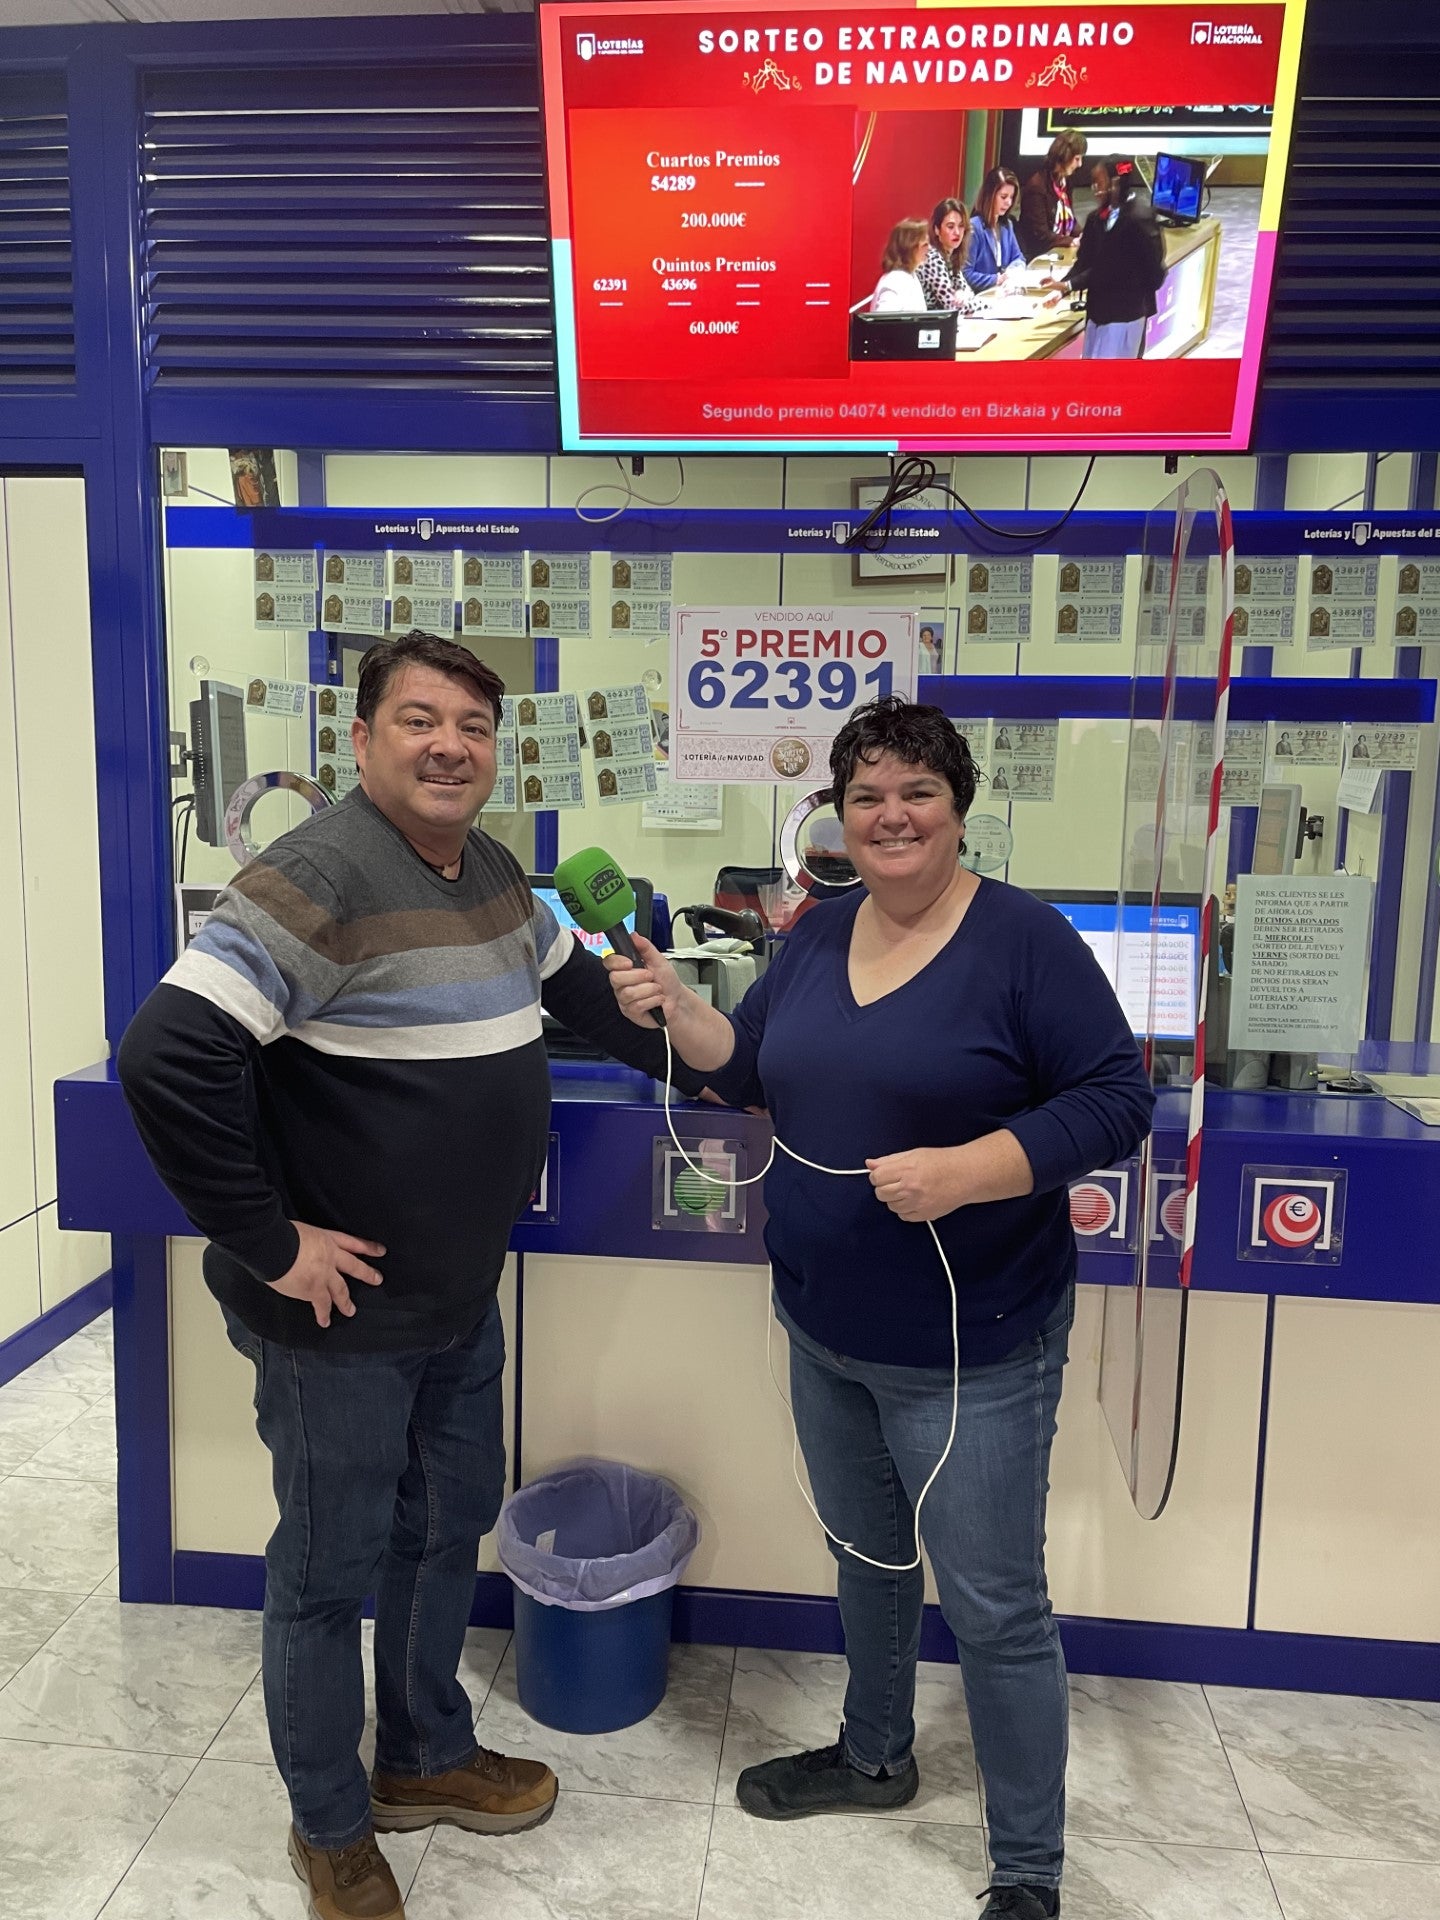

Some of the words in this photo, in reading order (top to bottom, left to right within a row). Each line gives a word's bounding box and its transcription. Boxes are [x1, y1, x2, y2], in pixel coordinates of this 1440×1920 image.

[1213, 24, 1255, 35] LOTERÍA
[597, 38, 644, 49] LOTERÍAS
[698, 29, 823, 54] SORTEO
[838, 22, 1134, 50] EXTRAORDINARIO
[1213, 34, 1263, 45] NACIONAL
[815, 62, 851, 86] DE
[866, 59, 1013, 84] NAVIDAD
[646, 151, 711, 168] Cuartos
[716, 150, 781, 167] Premios
[651, 175, 696, 191] 54289
[681, 212, 747, 228] 200.000€
[652, 257, 711, 274] Quintos
[716, 256, 776, 272] Premios
[593, 279, 628, 291] 62391
[661, 279, 697, 291] 43696
[689, 321, 740, 335] 60.000€
[702, 403, 773, 422] Segundo
[778, 404, 834, 422] premio
[839, 404, 886, 418] 04074
[892, 403, 956, 418] vendido
[961, 405, 981, 417] en
[987, 402, 1045, 417] Bizkaia
[1050, 406, 1061, 420] y
[1066, 402, 1122, 417] Girona
[375, 524, 409, 533] Loterías
[411, 526, 416, 534] y
[436, 525, 474, 534] Apuestas
[476, 524, 488, 533] del
[491, 525, 519, 533] Estado
[788, 528, 823, 537] Loterías
[825, 531, 831, 539] y
[893, 528, 907, 537] del
[909, 528, 940, 537] Estado
[1304, 528, 1342, 539] Loterías
[1344, 531, 1350, 540] y
[1373, 529, 1420, 540] Apuestas
[1422, 529, 1433, 538] del
[754, 612, 803, 622] VENDIDO
[806, 611, 834, 623] AQUÍ
[736, 629, 888, 659] PREMIO
[687, 660, 894, 711] 62391
[684, 752, 717, 761] LOTERÍA
[727, 754, 764, 762] NAVIDAD
[1295, 918, 1340, 926] ABONADOS
[1252, 951, 1288, 959] VIERNES
[1251, 960, 1288, 968] SABADO)
[1277, 969, 1326, 977] RETIRARLOS
[1249, 994, 1288, 1002] LOTERIAS
[1266, 1003, 1298, 1011] ESTADO
